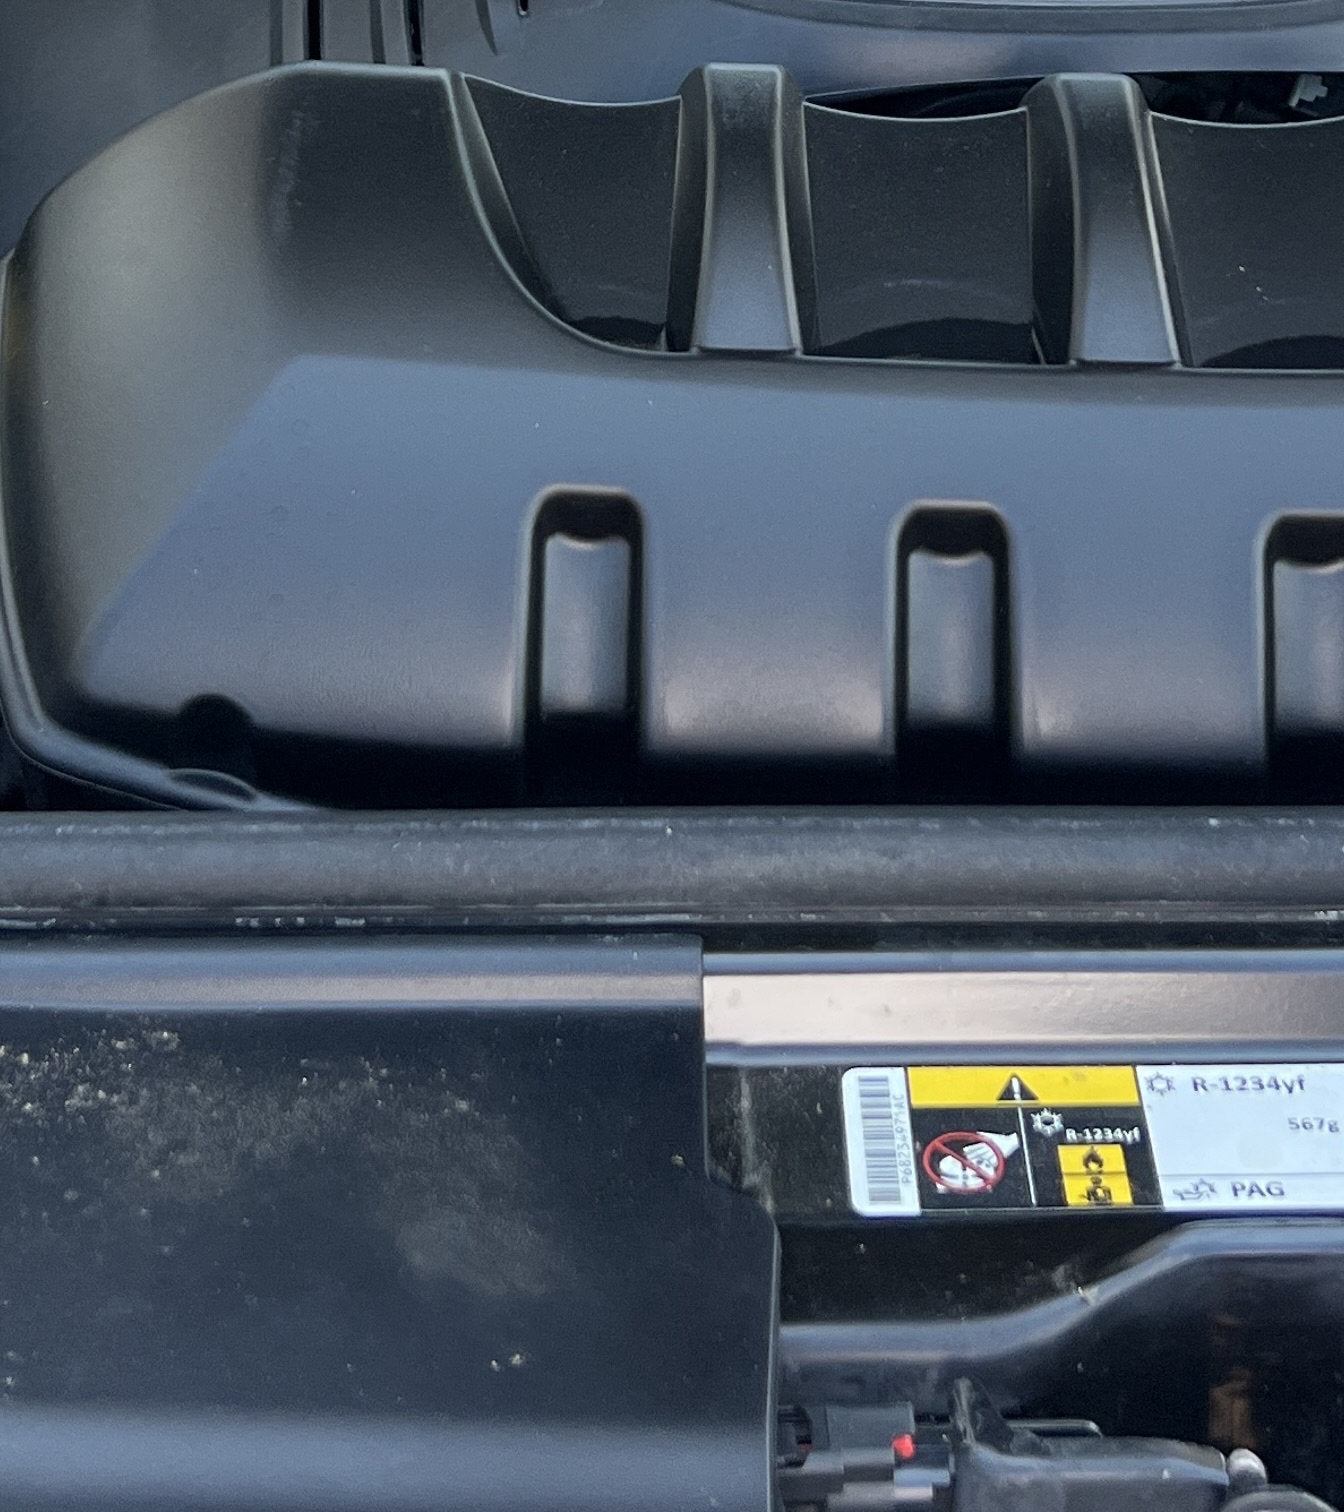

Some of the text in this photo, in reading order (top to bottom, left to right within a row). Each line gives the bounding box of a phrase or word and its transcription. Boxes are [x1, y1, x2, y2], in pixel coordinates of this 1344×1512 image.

[1191, 1075, 1306, 1094] R-1234yf
[1287, 1116, 1340, 1133] 567g
[1065, 1126, 1141, 1145] R-1234yf
[1230, 1181, 1285, 1197] PAG
